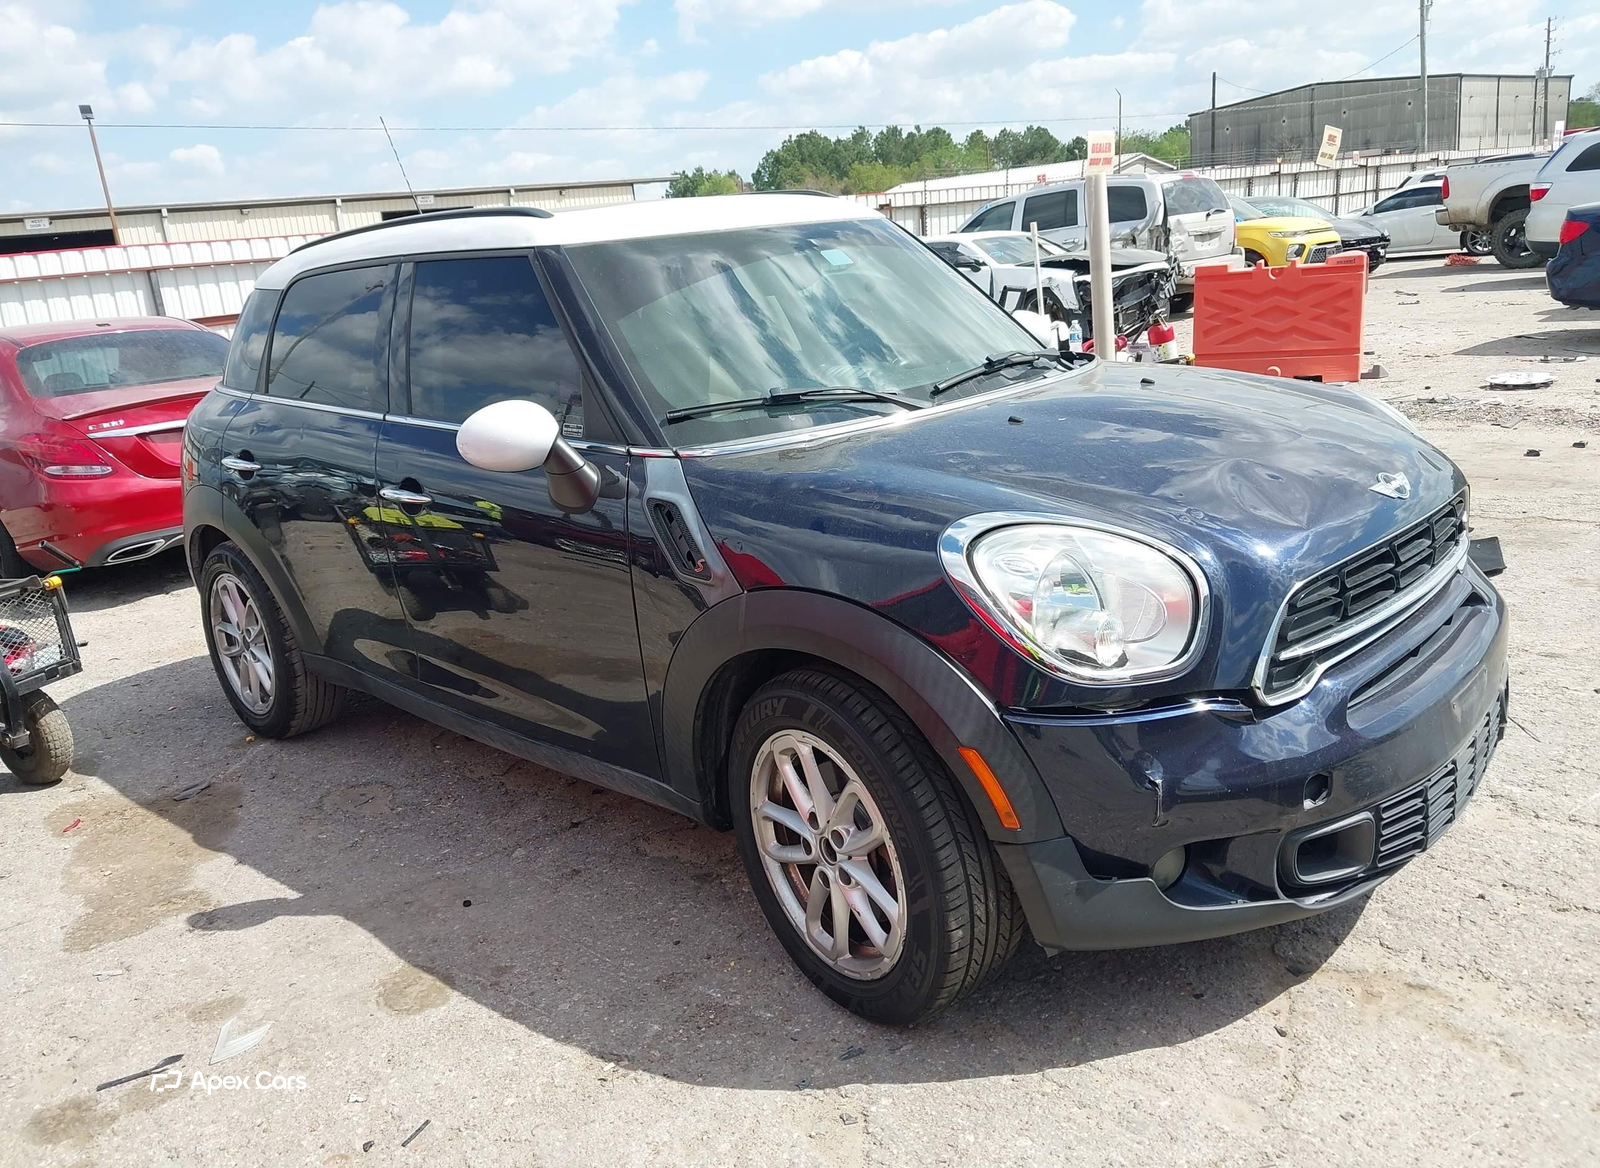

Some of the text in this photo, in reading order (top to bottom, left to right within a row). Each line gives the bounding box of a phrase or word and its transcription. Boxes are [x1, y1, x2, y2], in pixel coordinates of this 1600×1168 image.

[1091, 142, 1111, 153] DEALER
[695, 558, 705, 573] S
[841, 734, 912, 849] TOURING
